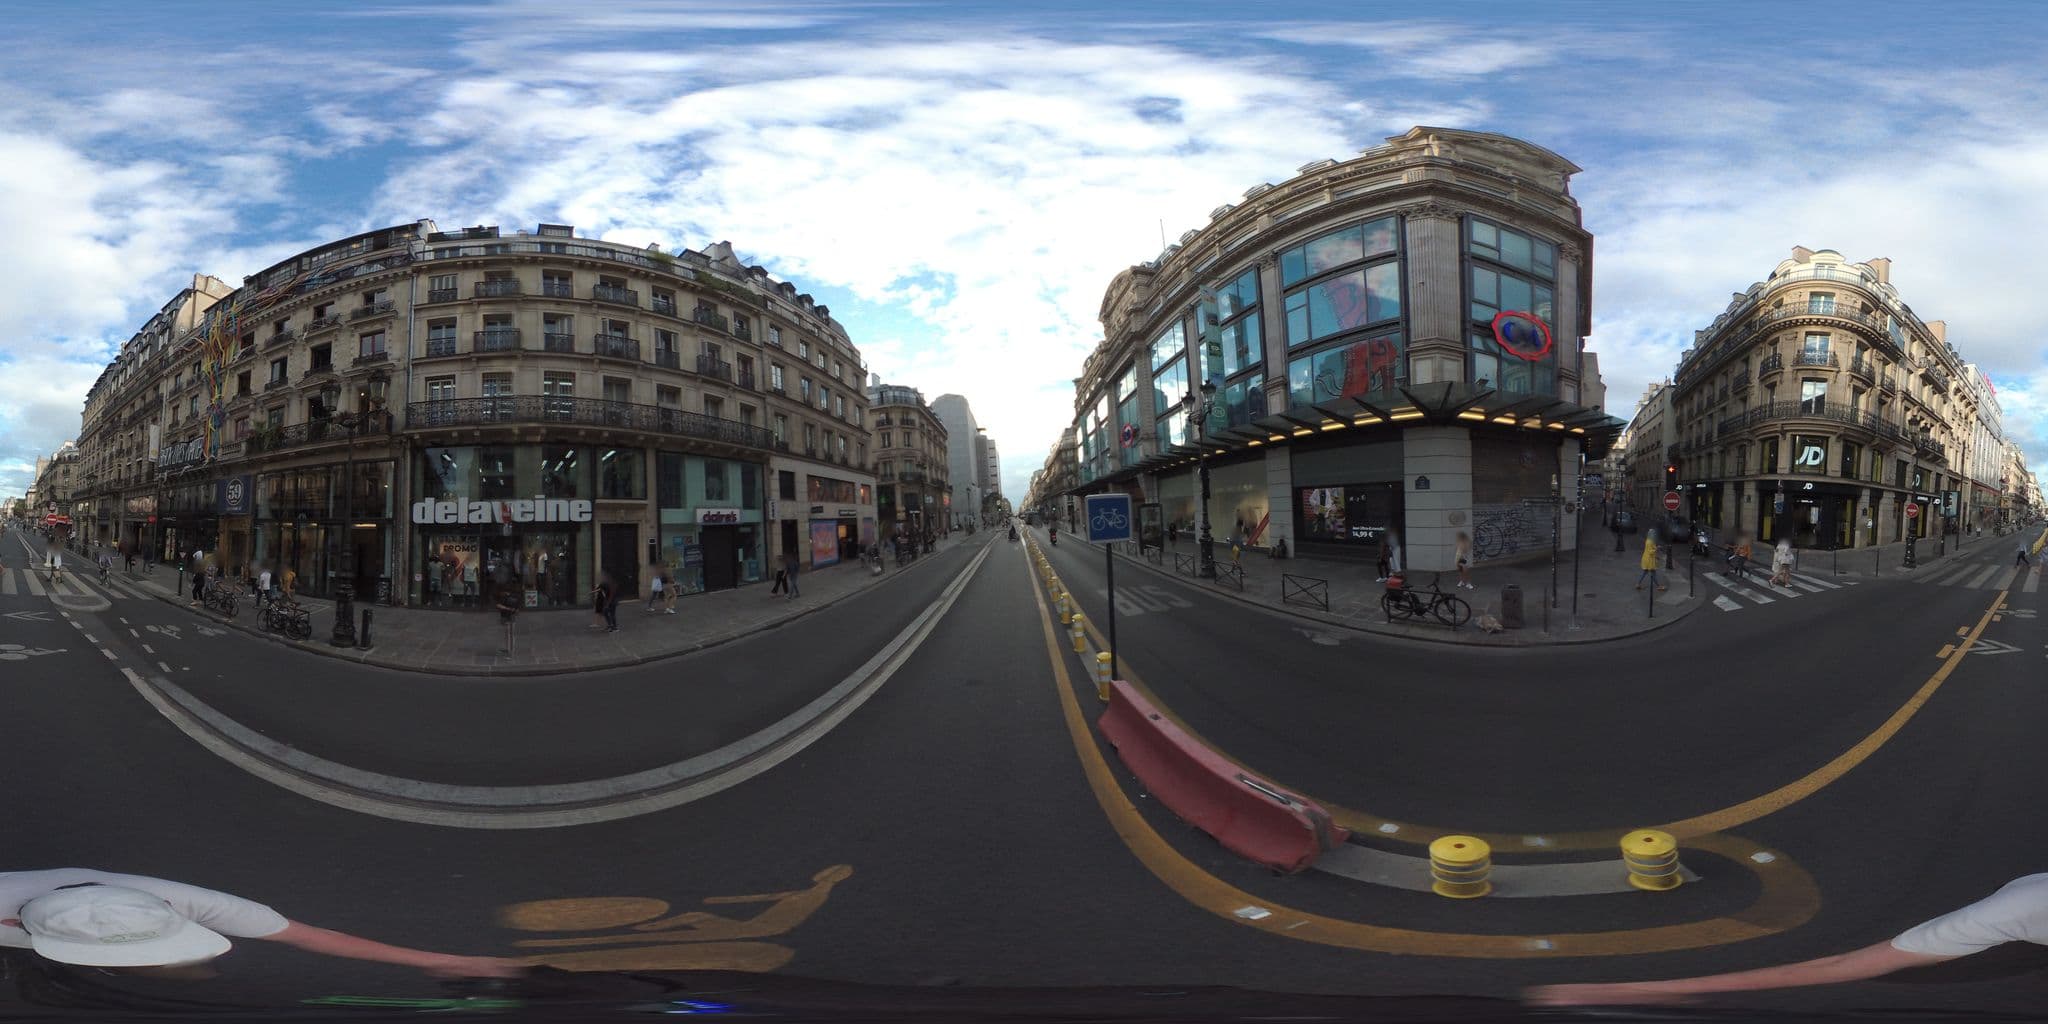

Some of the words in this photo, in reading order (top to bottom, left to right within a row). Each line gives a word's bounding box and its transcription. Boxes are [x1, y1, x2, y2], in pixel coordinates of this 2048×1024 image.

[1795, 446, 1825, 466] JD
[228, 484, 242, 499] 59
[412, 495, 592, 524] delaveine
[443, 544, 477, 553] PROMO
